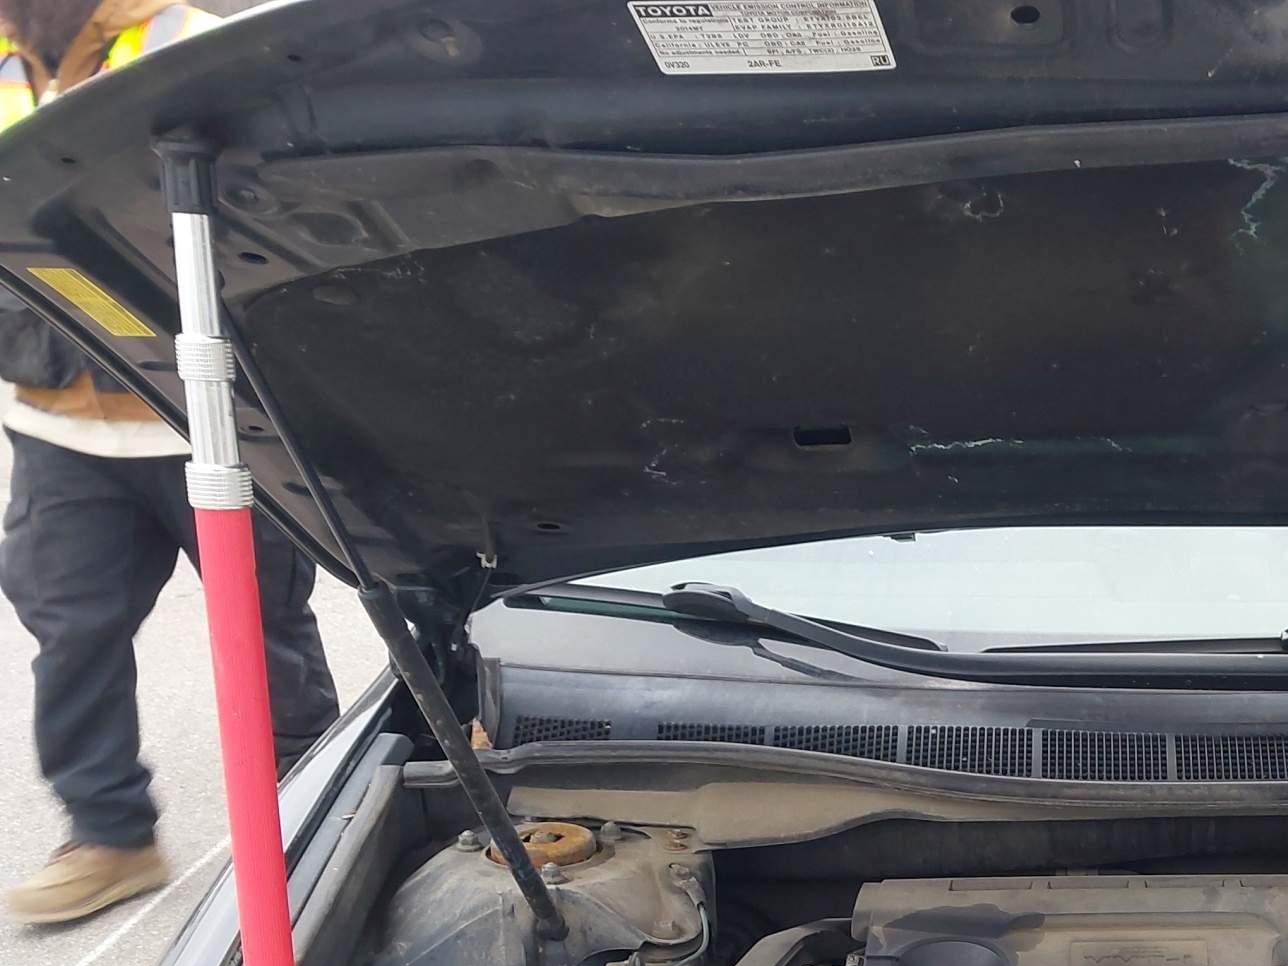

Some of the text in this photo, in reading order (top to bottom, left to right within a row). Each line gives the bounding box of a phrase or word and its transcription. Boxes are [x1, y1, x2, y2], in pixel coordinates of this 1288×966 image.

[634, 6, 711, 16] TOYOTA
[747, 60, 782, 68] 2AR-FE
[872, 56, 890, 66] RU
